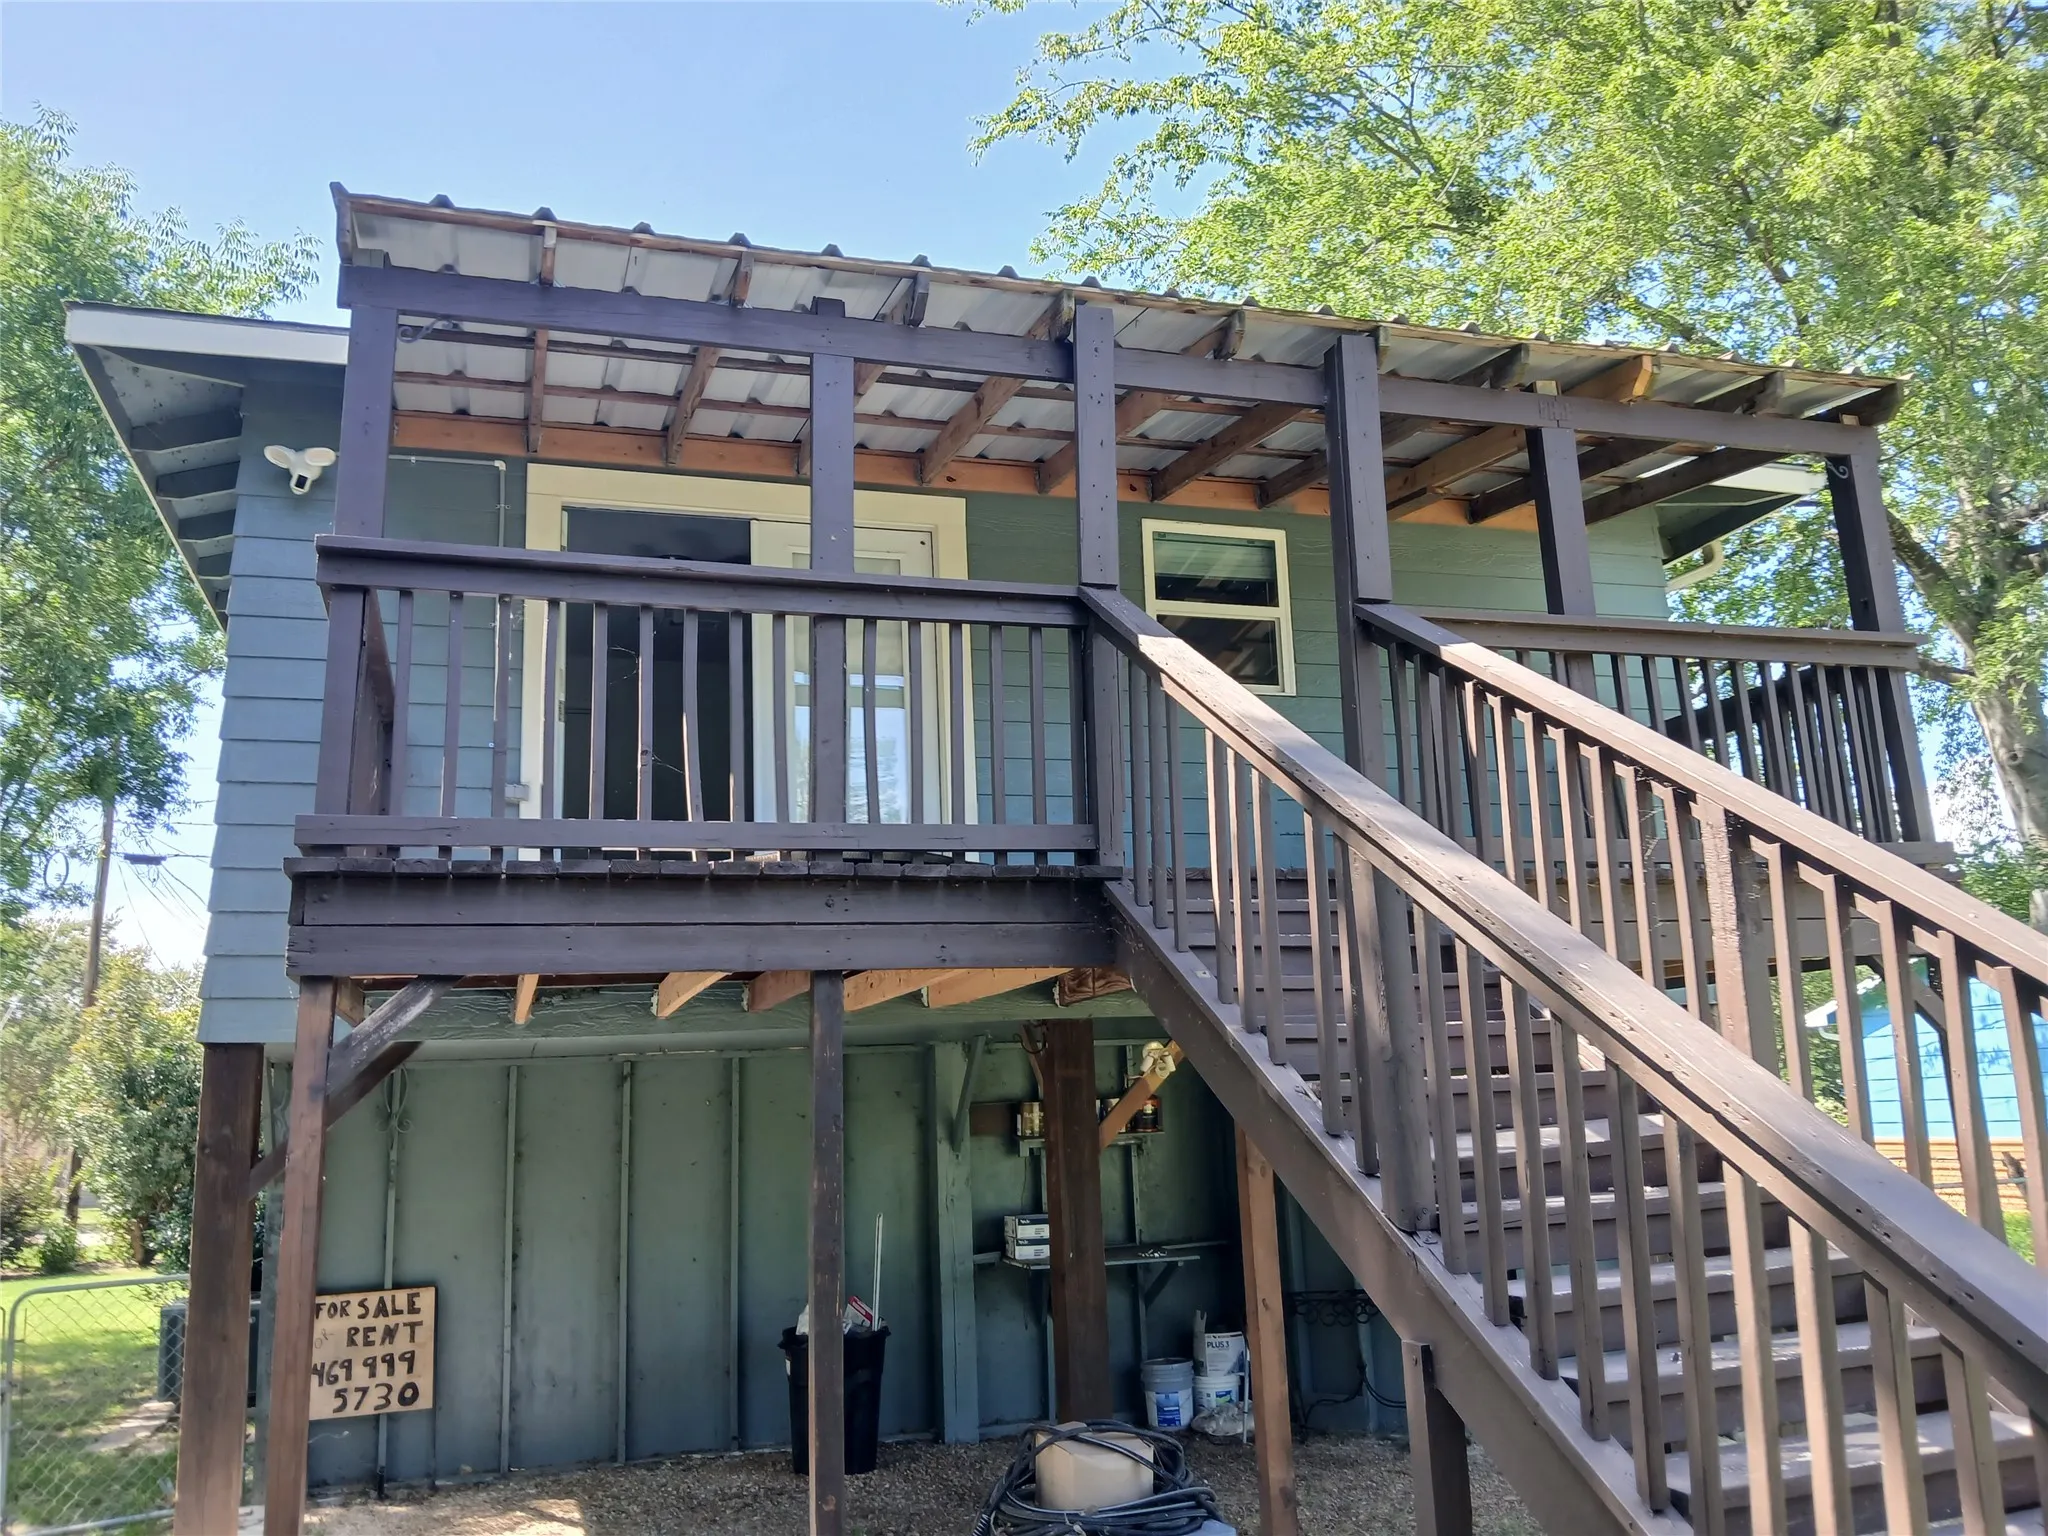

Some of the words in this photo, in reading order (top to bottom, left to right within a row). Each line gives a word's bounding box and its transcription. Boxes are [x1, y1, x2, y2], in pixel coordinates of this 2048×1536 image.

[315, 1300, 351, 1319] FOR
[357, 1292, 421, 1319] SALE
[346, 1320, 423, 1347] RENT
[311, 1359, 353, 1387] 469
[362, 1350, 415, 1379] 999
[333, 1381, 419, 1414] 5730
